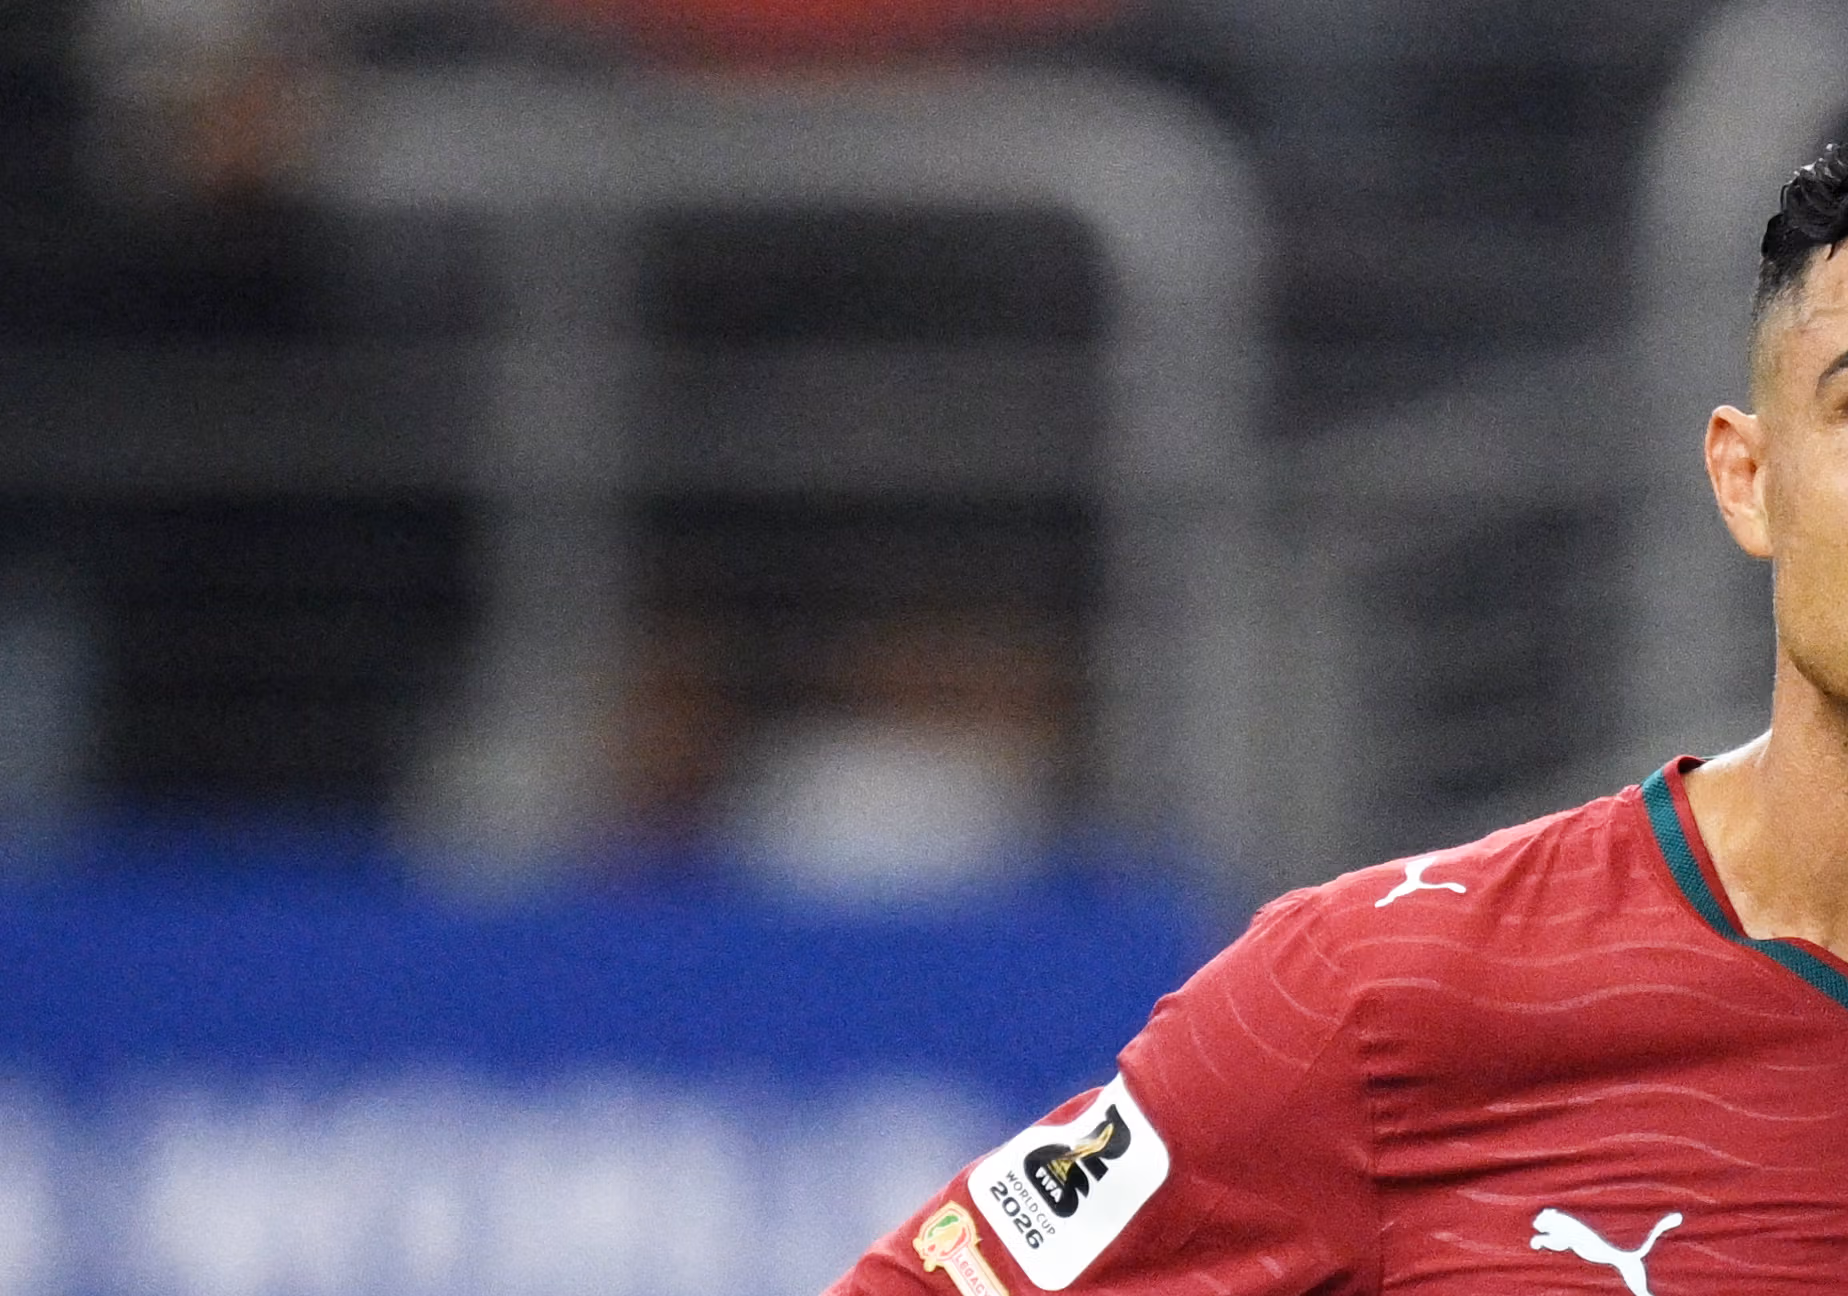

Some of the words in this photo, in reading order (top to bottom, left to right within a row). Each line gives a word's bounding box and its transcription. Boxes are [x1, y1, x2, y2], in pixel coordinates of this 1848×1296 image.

[989, 1181, 1044, 1250] 2026
[1005, 1170, 1039, 1213] WORLD
[1036, 1213, 1056, 1235] CUP
[1035, 1166, 1062, 1203] FIFA
